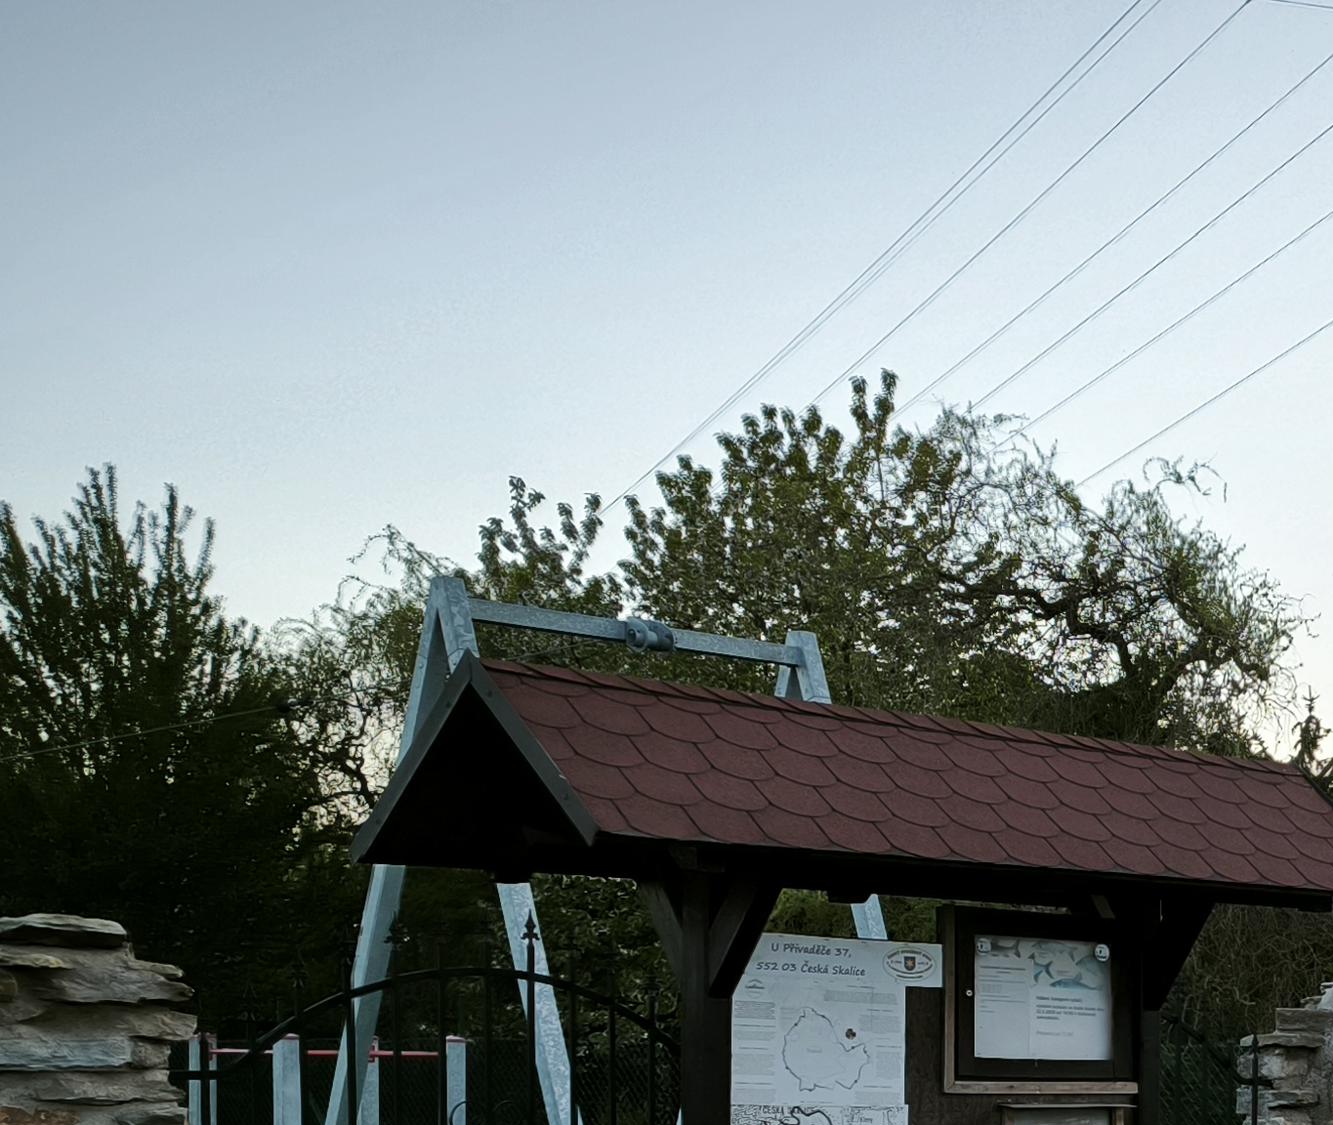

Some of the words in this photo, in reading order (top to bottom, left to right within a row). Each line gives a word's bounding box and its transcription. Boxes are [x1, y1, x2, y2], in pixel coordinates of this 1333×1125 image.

[771, 943, 780, 952] U
[783, 943, 831, 956] Přivaděče
[756, 962, 778, 971] 552
[782, 962, 797, 971] 03
[801, 960, 829, 974] Česká
[832, 966, 866, 976] Skalice
